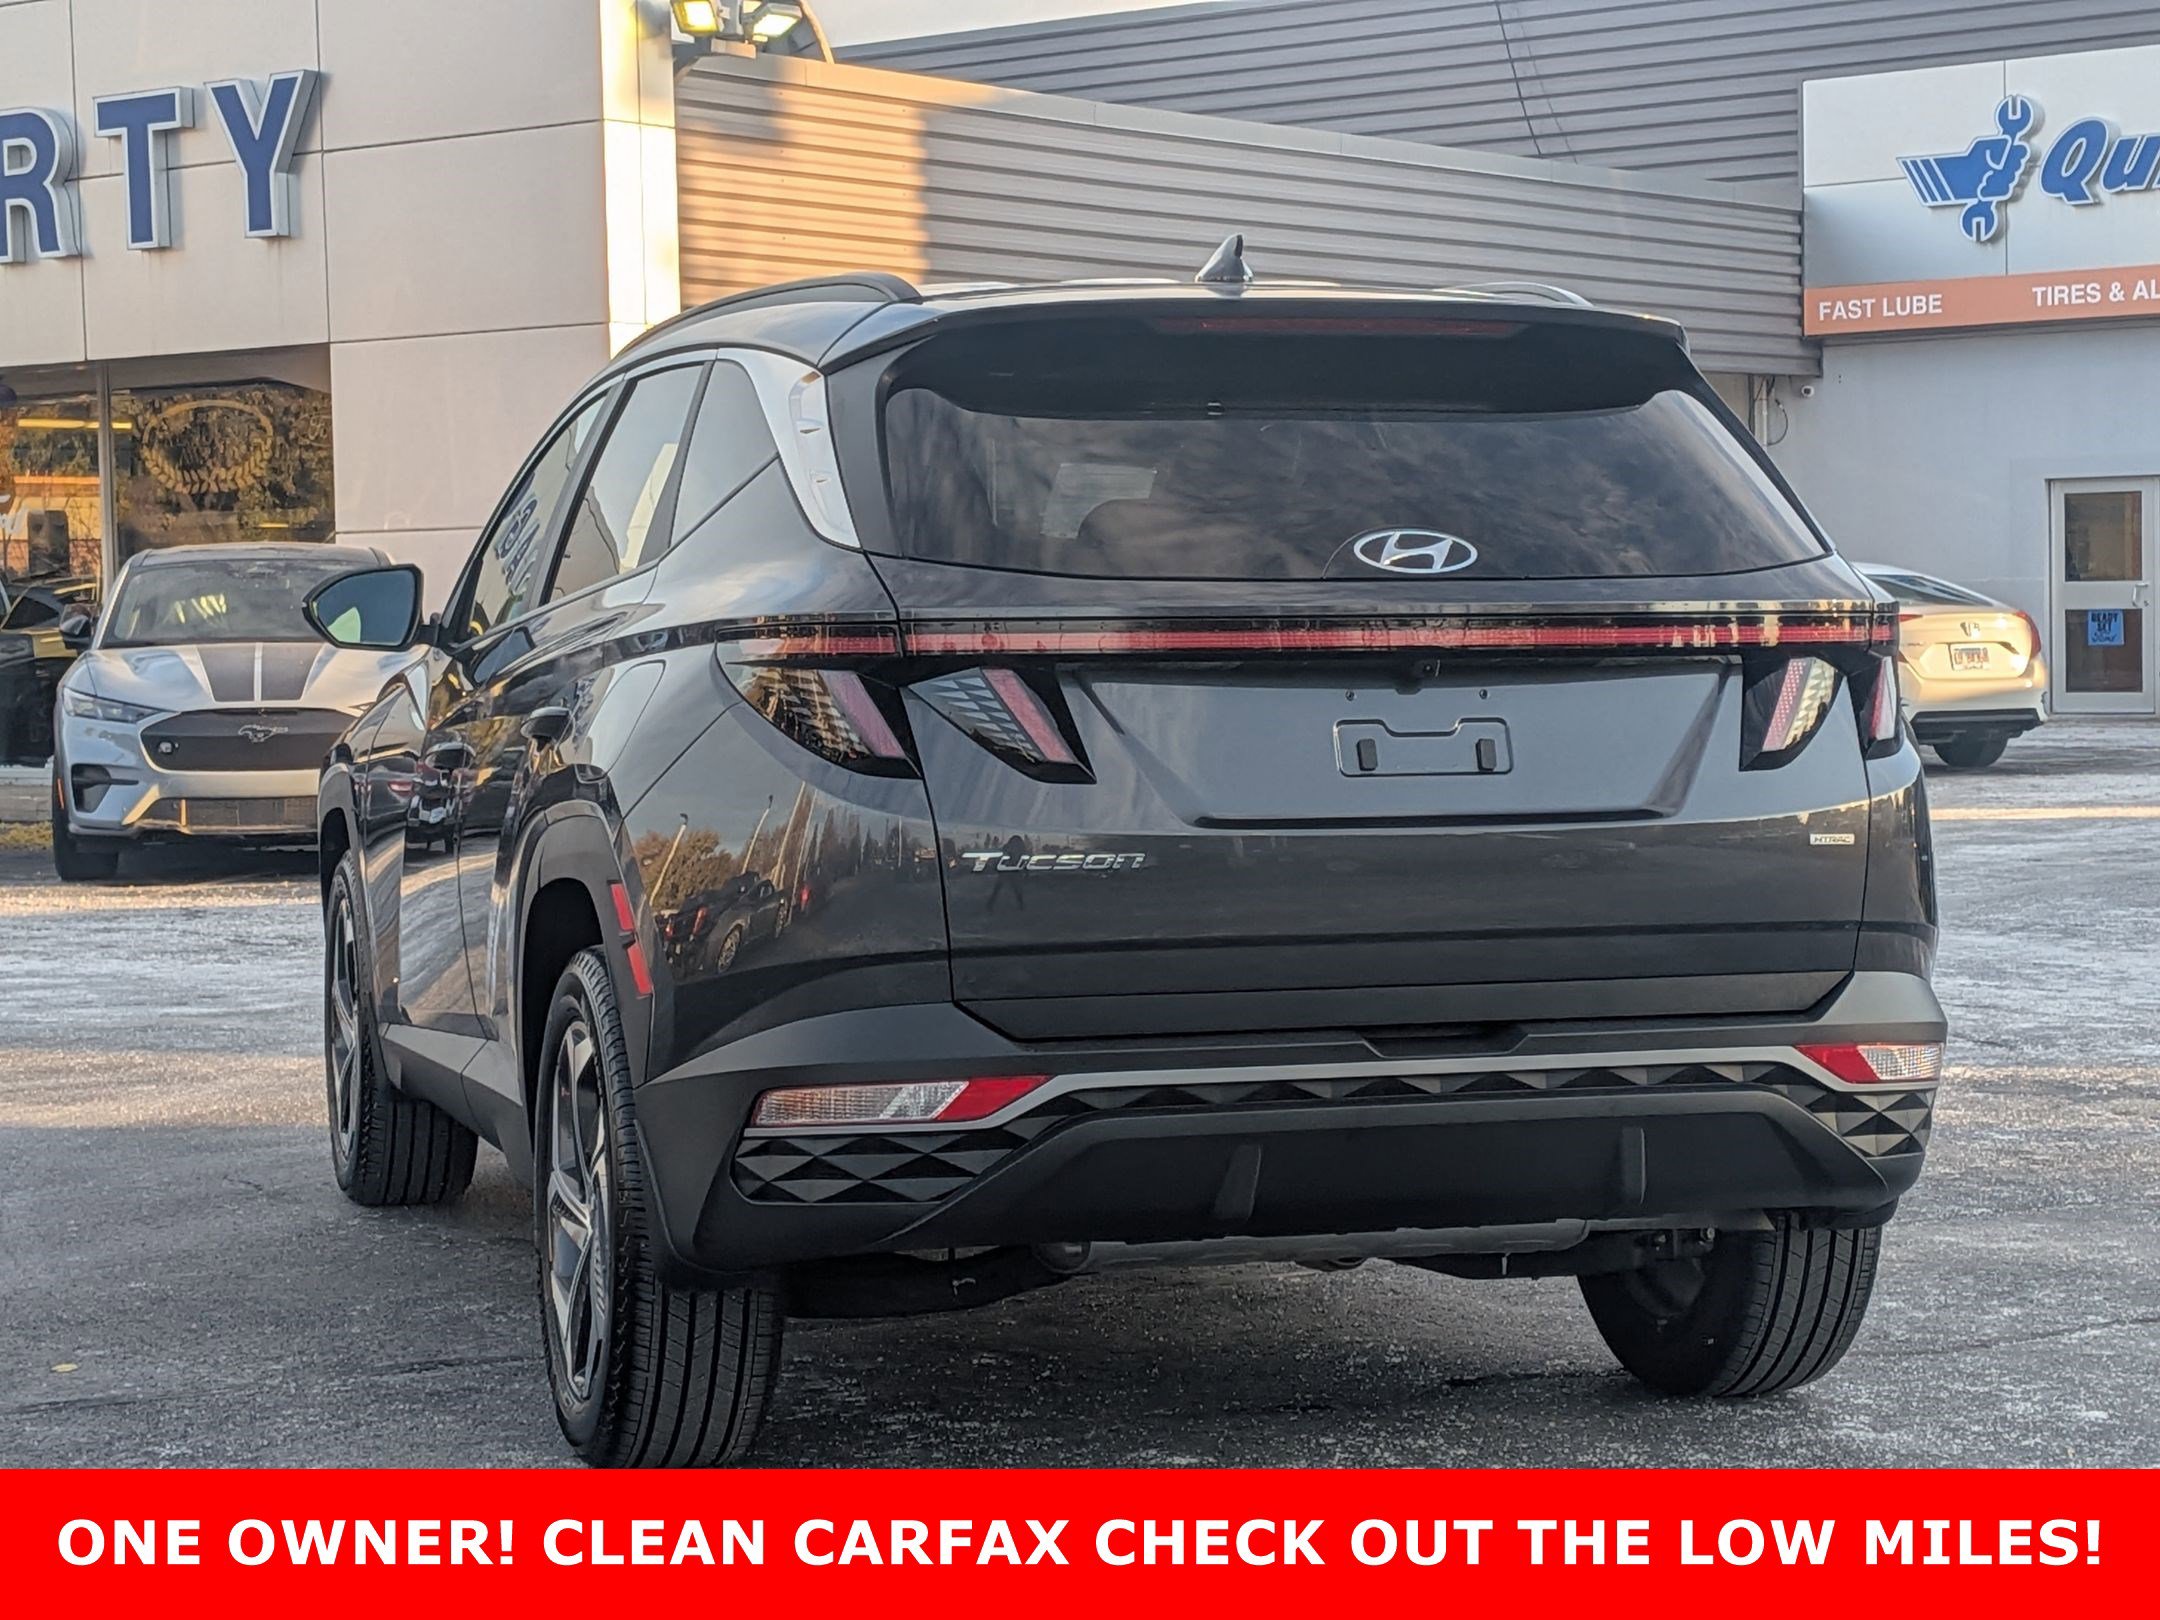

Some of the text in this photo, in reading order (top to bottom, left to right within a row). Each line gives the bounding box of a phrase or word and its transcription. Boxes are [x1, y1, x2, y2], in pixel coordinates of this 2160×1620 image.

[0, 69, 318, 264] RTY
[2040, 116, 2160, 205] Qu
[1818, 293, 1943, 322] FAST LUBE
[2031, 282, 2102, 307] TIRES
[2108, 281, 2126, 303] &
